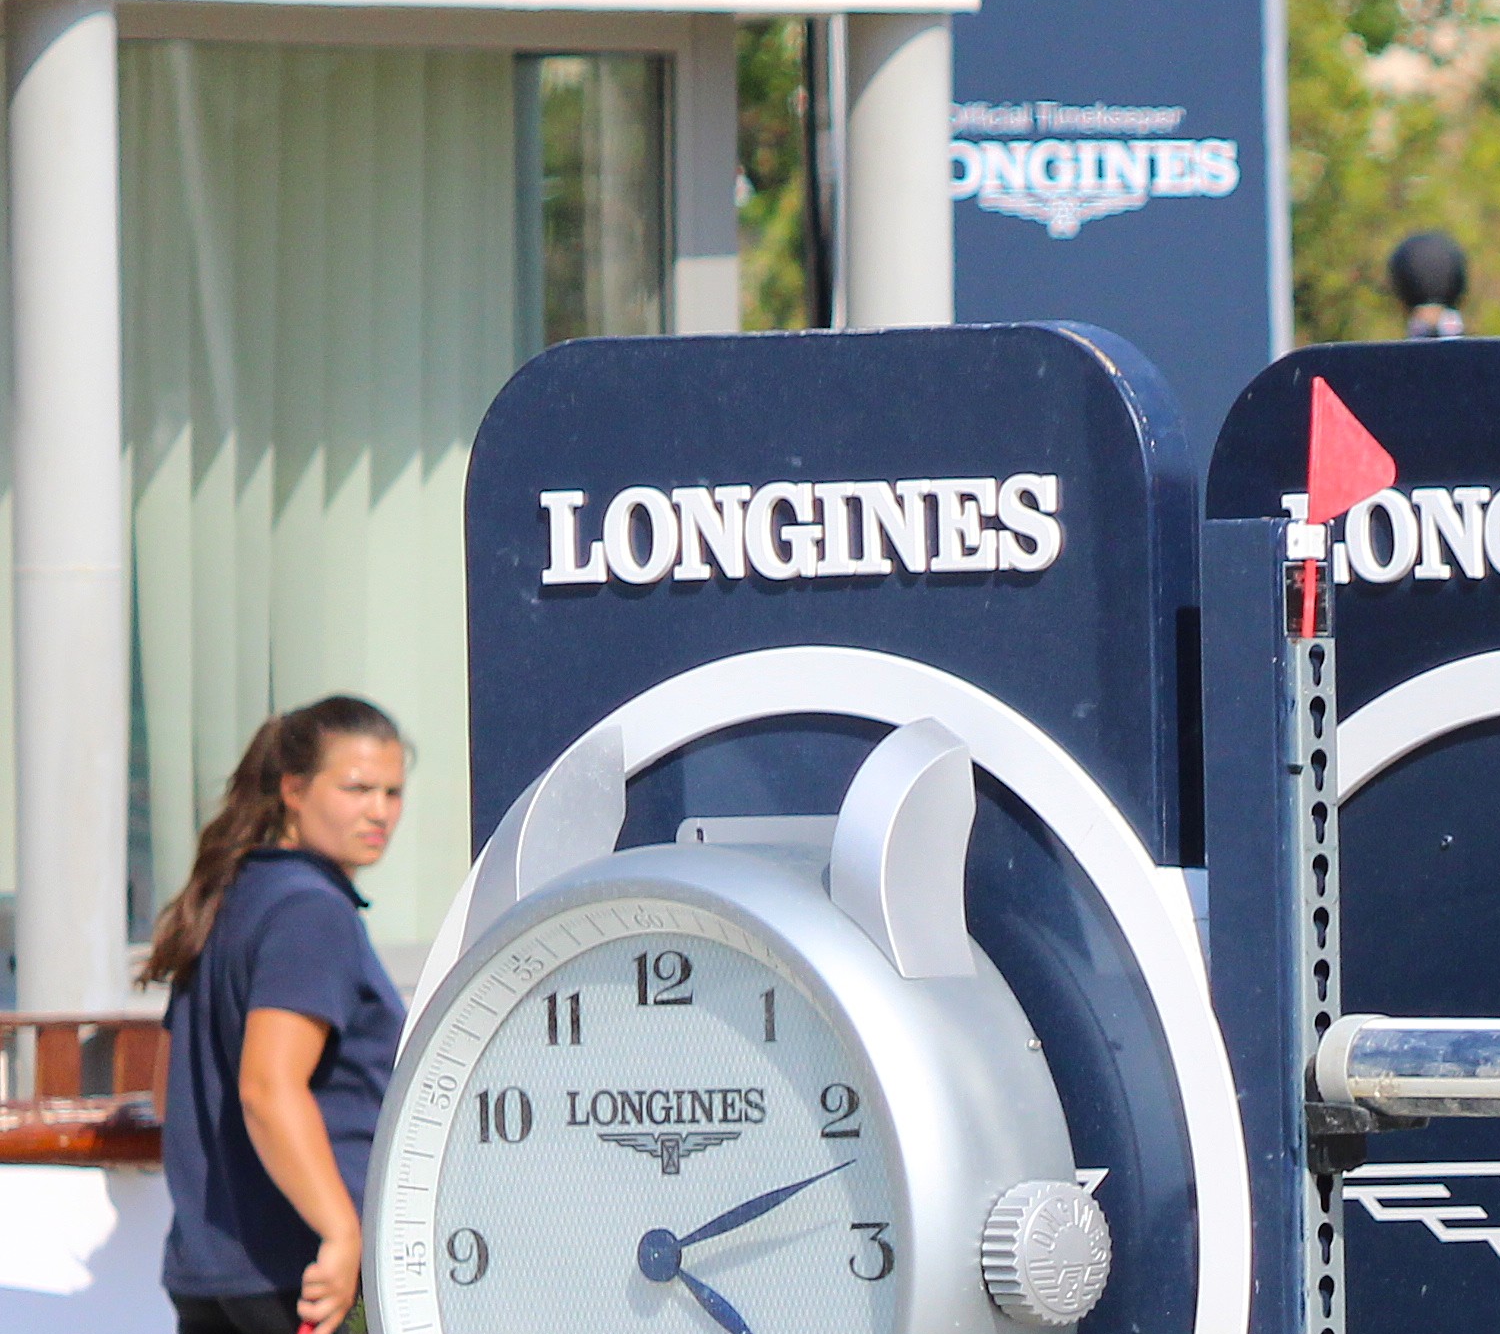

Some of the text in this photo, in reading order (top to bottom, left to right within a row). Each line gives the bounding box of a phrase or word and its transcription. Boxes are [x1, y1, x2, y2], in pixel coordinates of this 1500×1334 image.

[949, 139, 1240, 200] ONGINES
[539, 473, 1062, 585] LONGINES
[633, 950, 694, 1006] 12
[543, 990, 582, 1046] 11
[760, 987, 777, 1042] 1
[475, 1086, 533, 1144] 10
[566, 1087, 767, 1127] LONGINES
[820, 1083, 862, 1140] 2
[446, 1227, 489, 1286] 9
[849, 1222, 896, 1281] 3
